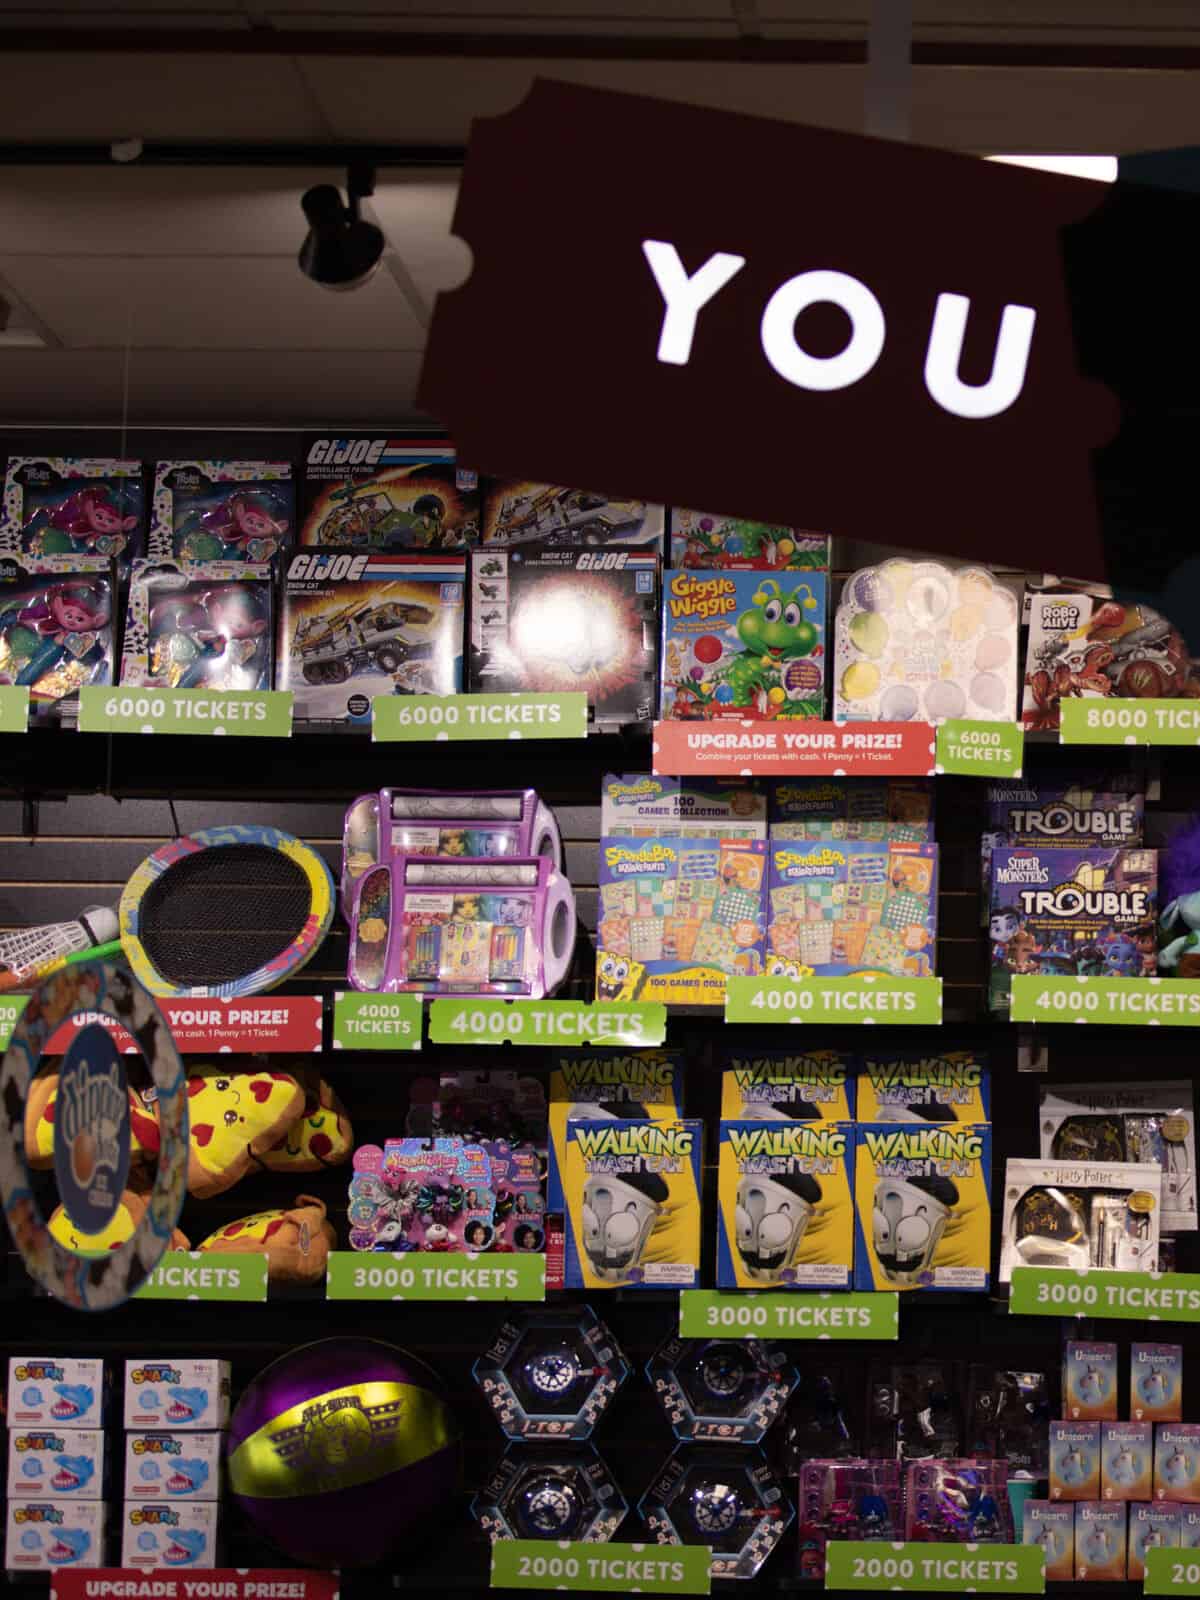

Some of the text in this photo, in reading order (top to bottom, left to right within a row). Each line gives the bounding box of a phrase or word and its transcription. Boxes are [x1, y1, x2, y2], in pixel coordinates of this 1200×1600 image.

[643, 240, 1035, 418] YOU
[671, 573, 737, 597] Giggle
[670, 596, 737, 619] Wiggle
[1042, 606, 1079, 619] ROBO
[1042, 618, 1079, 630] ALIVE
[105, 698, 265, 720] 6000 TICKETS
[400, 704, 560, 724] 6000 TICKETS
[1088, 709, 1147, 728] 8000
[688, 734, 902, 748] UPGRADE YOUR PRIZE!
[959, 732, 1000, 748] 6000
[948, 743, 1011, 761] TICKETS
[1010, 806, 1134, 834] TROUBLE
[1102, 833, 1126, 841] GAME
[1008, 856, 1040, 870] SUPER
[997, 867, 1049, 884] MONSTERS
[1020, 888, 1147, 917] TROUBLE
[1115, 914, 1139, 923] GAME
[752, 991, 915, 1010] 4000 TICKETS
[1036, 992, 1200, 1012] 4000 TICKETS
[169, 1010, 288, 1025] YOUR PRIZE!
[358, 1005, 399, 1017] 4000
[346, 1020, 410, 1033] TICKETS
[451, 1012, 646, 1038] 4000 TICKETS
[731, 1057, 848, 1086] WALKING
[865, 1057, 982, 1088] WALKING
[575, 1126, 694, 1156] WALKING
[728, 1127, 847, 1157] WALKING
[864, 1130, 983, 1160] WALKING
[1056, 1170, 1113, 1184] Harry Potter
[355, 1268, 518, 1288] 3000 TICKETS
[1037, 1283, 1200, 1309] 3000 TICKETS
[708, 1307, 870, 1326] 3000 TICKETS
[15, 1365, 64, 1381] SHARK
[131, 1369, 183, 1385] SHARK
[15, 1437, 65, 1453] SHARK
[132, 1440, 183, 1456] SHARK
[15, 1508, 65, 1525] SHARK
[130, 1510, 180, 1526] SHARK
[518, 1557, 579, 1577] 2000
[587, 1559, 683, 1581] TICKETS
[853, 1558, 1017, 1580] 2000 TICKETS
[86, 1581, 305, 1597] UPGRADE YOUR PRIZE!
